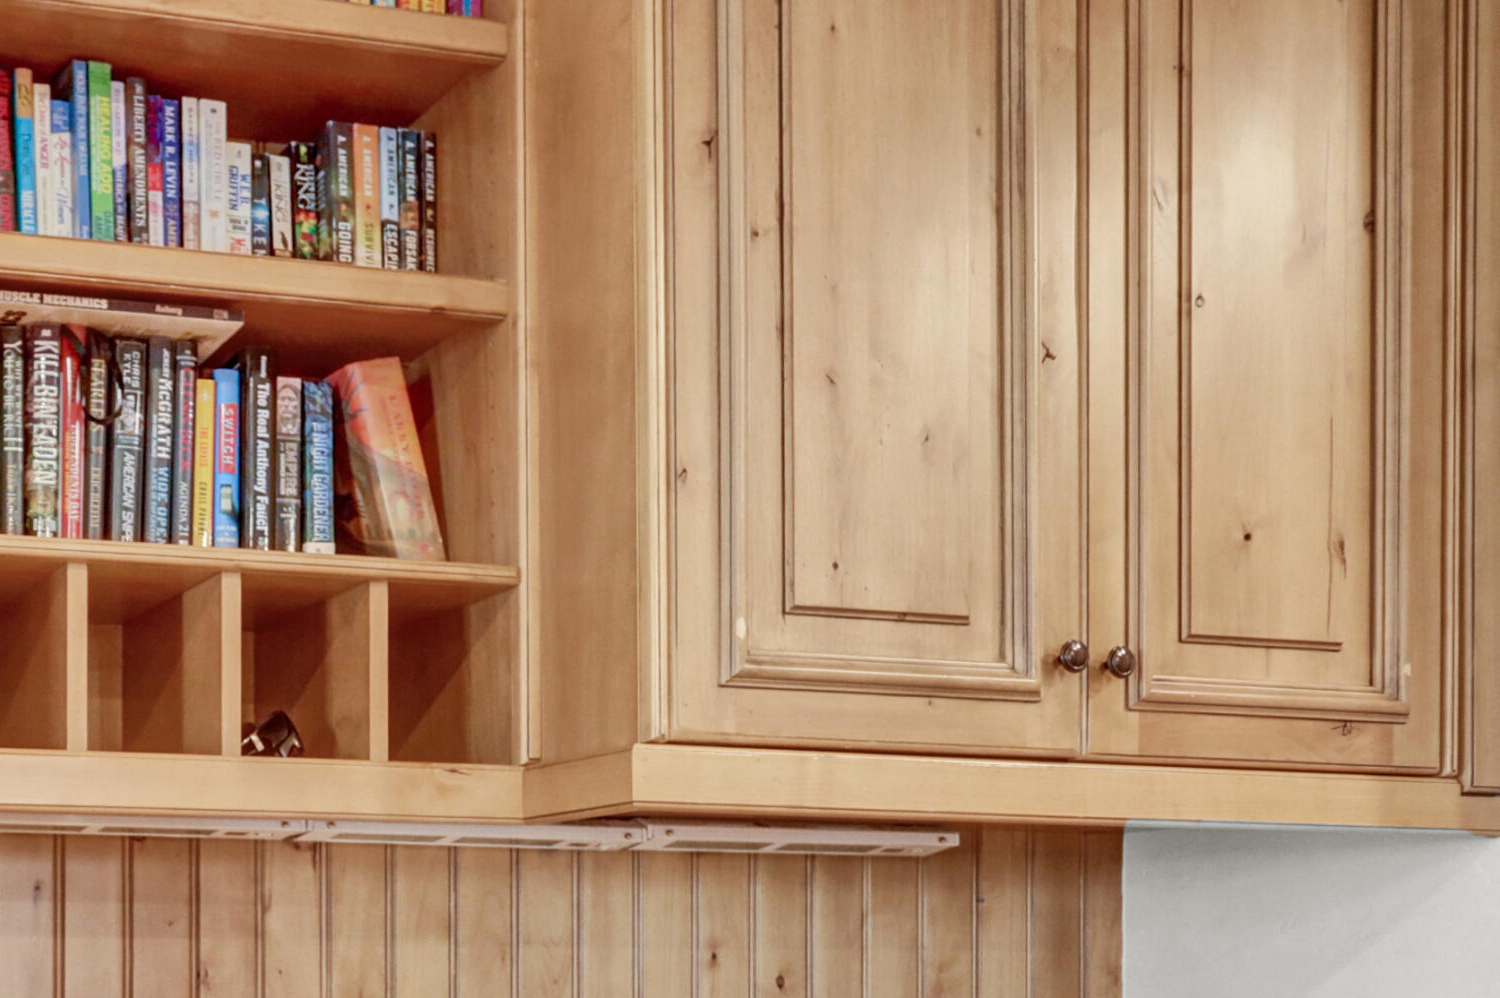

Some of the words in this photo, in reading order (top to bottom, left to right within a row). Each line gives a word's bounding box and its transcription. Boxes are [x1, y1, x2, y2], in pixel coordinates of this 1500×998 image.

[99, 96, 110, 160] HEALING
[132, 96, 145, 145] LIBERTY
[164, 106, 175, 142] MARK
[336, 134, 347, 145] A.
[165, 145, 175, 158] R.
[337, 148, 348, 197] AMERICAN
[363, 149, 373, 197] AMERICAN
[387, 150, 397, 196] AMERICAN
[100, 163, 112, 195] ADD
[133, 146, 147, 227] AMENDMENTS
[165, 160, 177, 198] LEVIN
[229, 165, 240, 211] GRIFFIN
[295, 163, 311, 211] KING
[405, 154, 417, 202] AMERICAN
[425, 153, 436, 202] AMERICAN
[338, 221, 352, 262] GOING
[42, 293, 109, 310] MECHANICS
[33, 341, 59, 382] KILL
[122, 353, 131, 386] KYLE
[131, 351, 140, 389] CHRIS
[33, 385, 59, 418] BIN
[90, 358, 105, 433] FEARLES
[256, 383, 268, 405] The
[157, 378, 173, 460] McGRATH
[222, 408, 234, 466] SWITCH
[256, 408, 268, 437] Real
[32, 423, 59, 485] LADEN
[253, 440, 269, 491] Anthony
[284, 442, 298, 497] EMPIRE
[311, 433, 329, 470] NIGHT
[122, 451, 137, 508] AMERICAN
[157, 467, 170, 502] WIDE
[179, 481, 188, 522] AGENDA
[255, 493, 269, 532] Fauci
[311, 473, 330, 542] GARDENER
[178, 524, 188, 537] 21
